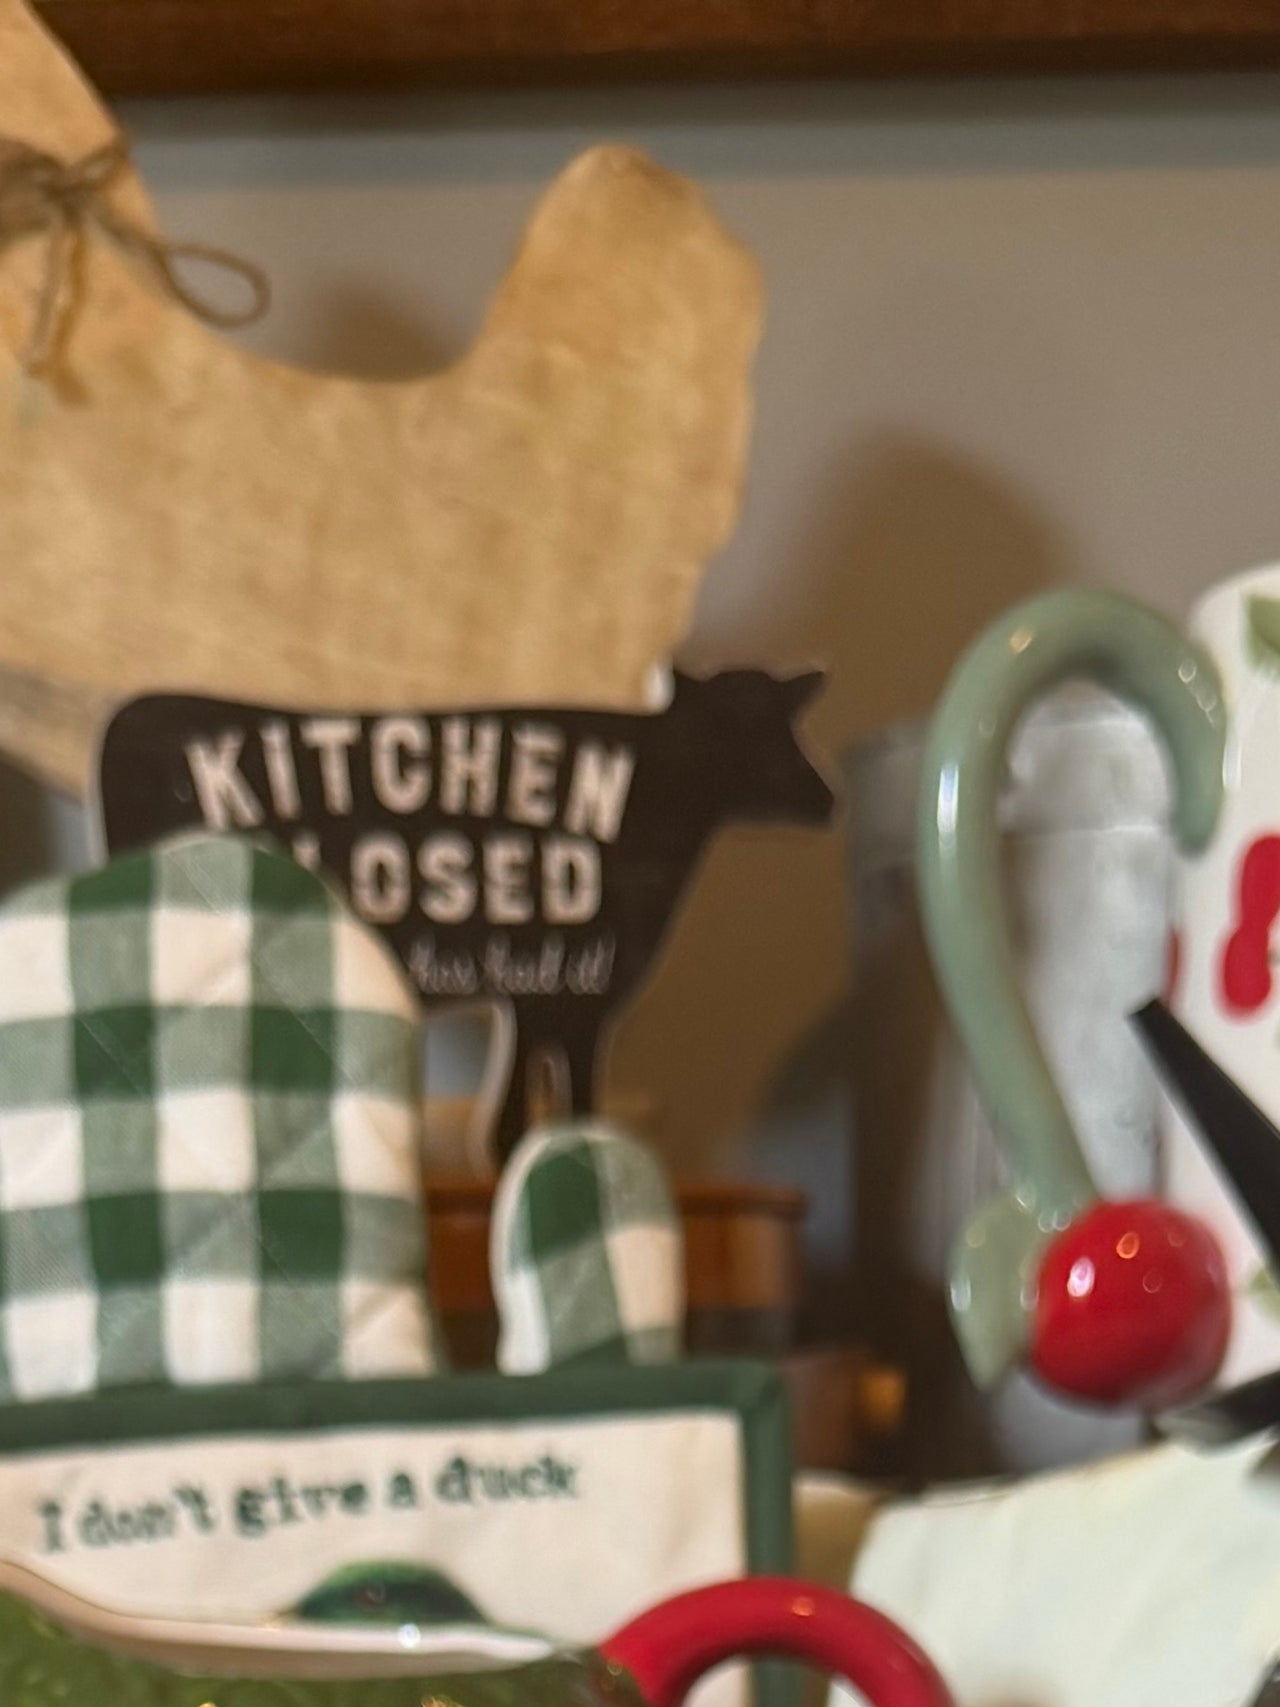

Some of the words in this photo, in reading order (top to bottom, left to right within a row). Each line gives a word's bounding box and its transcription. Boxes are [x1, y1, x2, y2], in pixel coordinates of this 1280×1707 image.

[184, 715, 637, 844] KITCHEN
[293, 829, 604, 926] OSED
[37, 1497, 66, 1554] I
[77, 1481, 215, 1548] don't
[235, 1475, 368, 1538] give
[388, 1472, 418, 1511] a
[434, 1454, 580, 1504] duck
